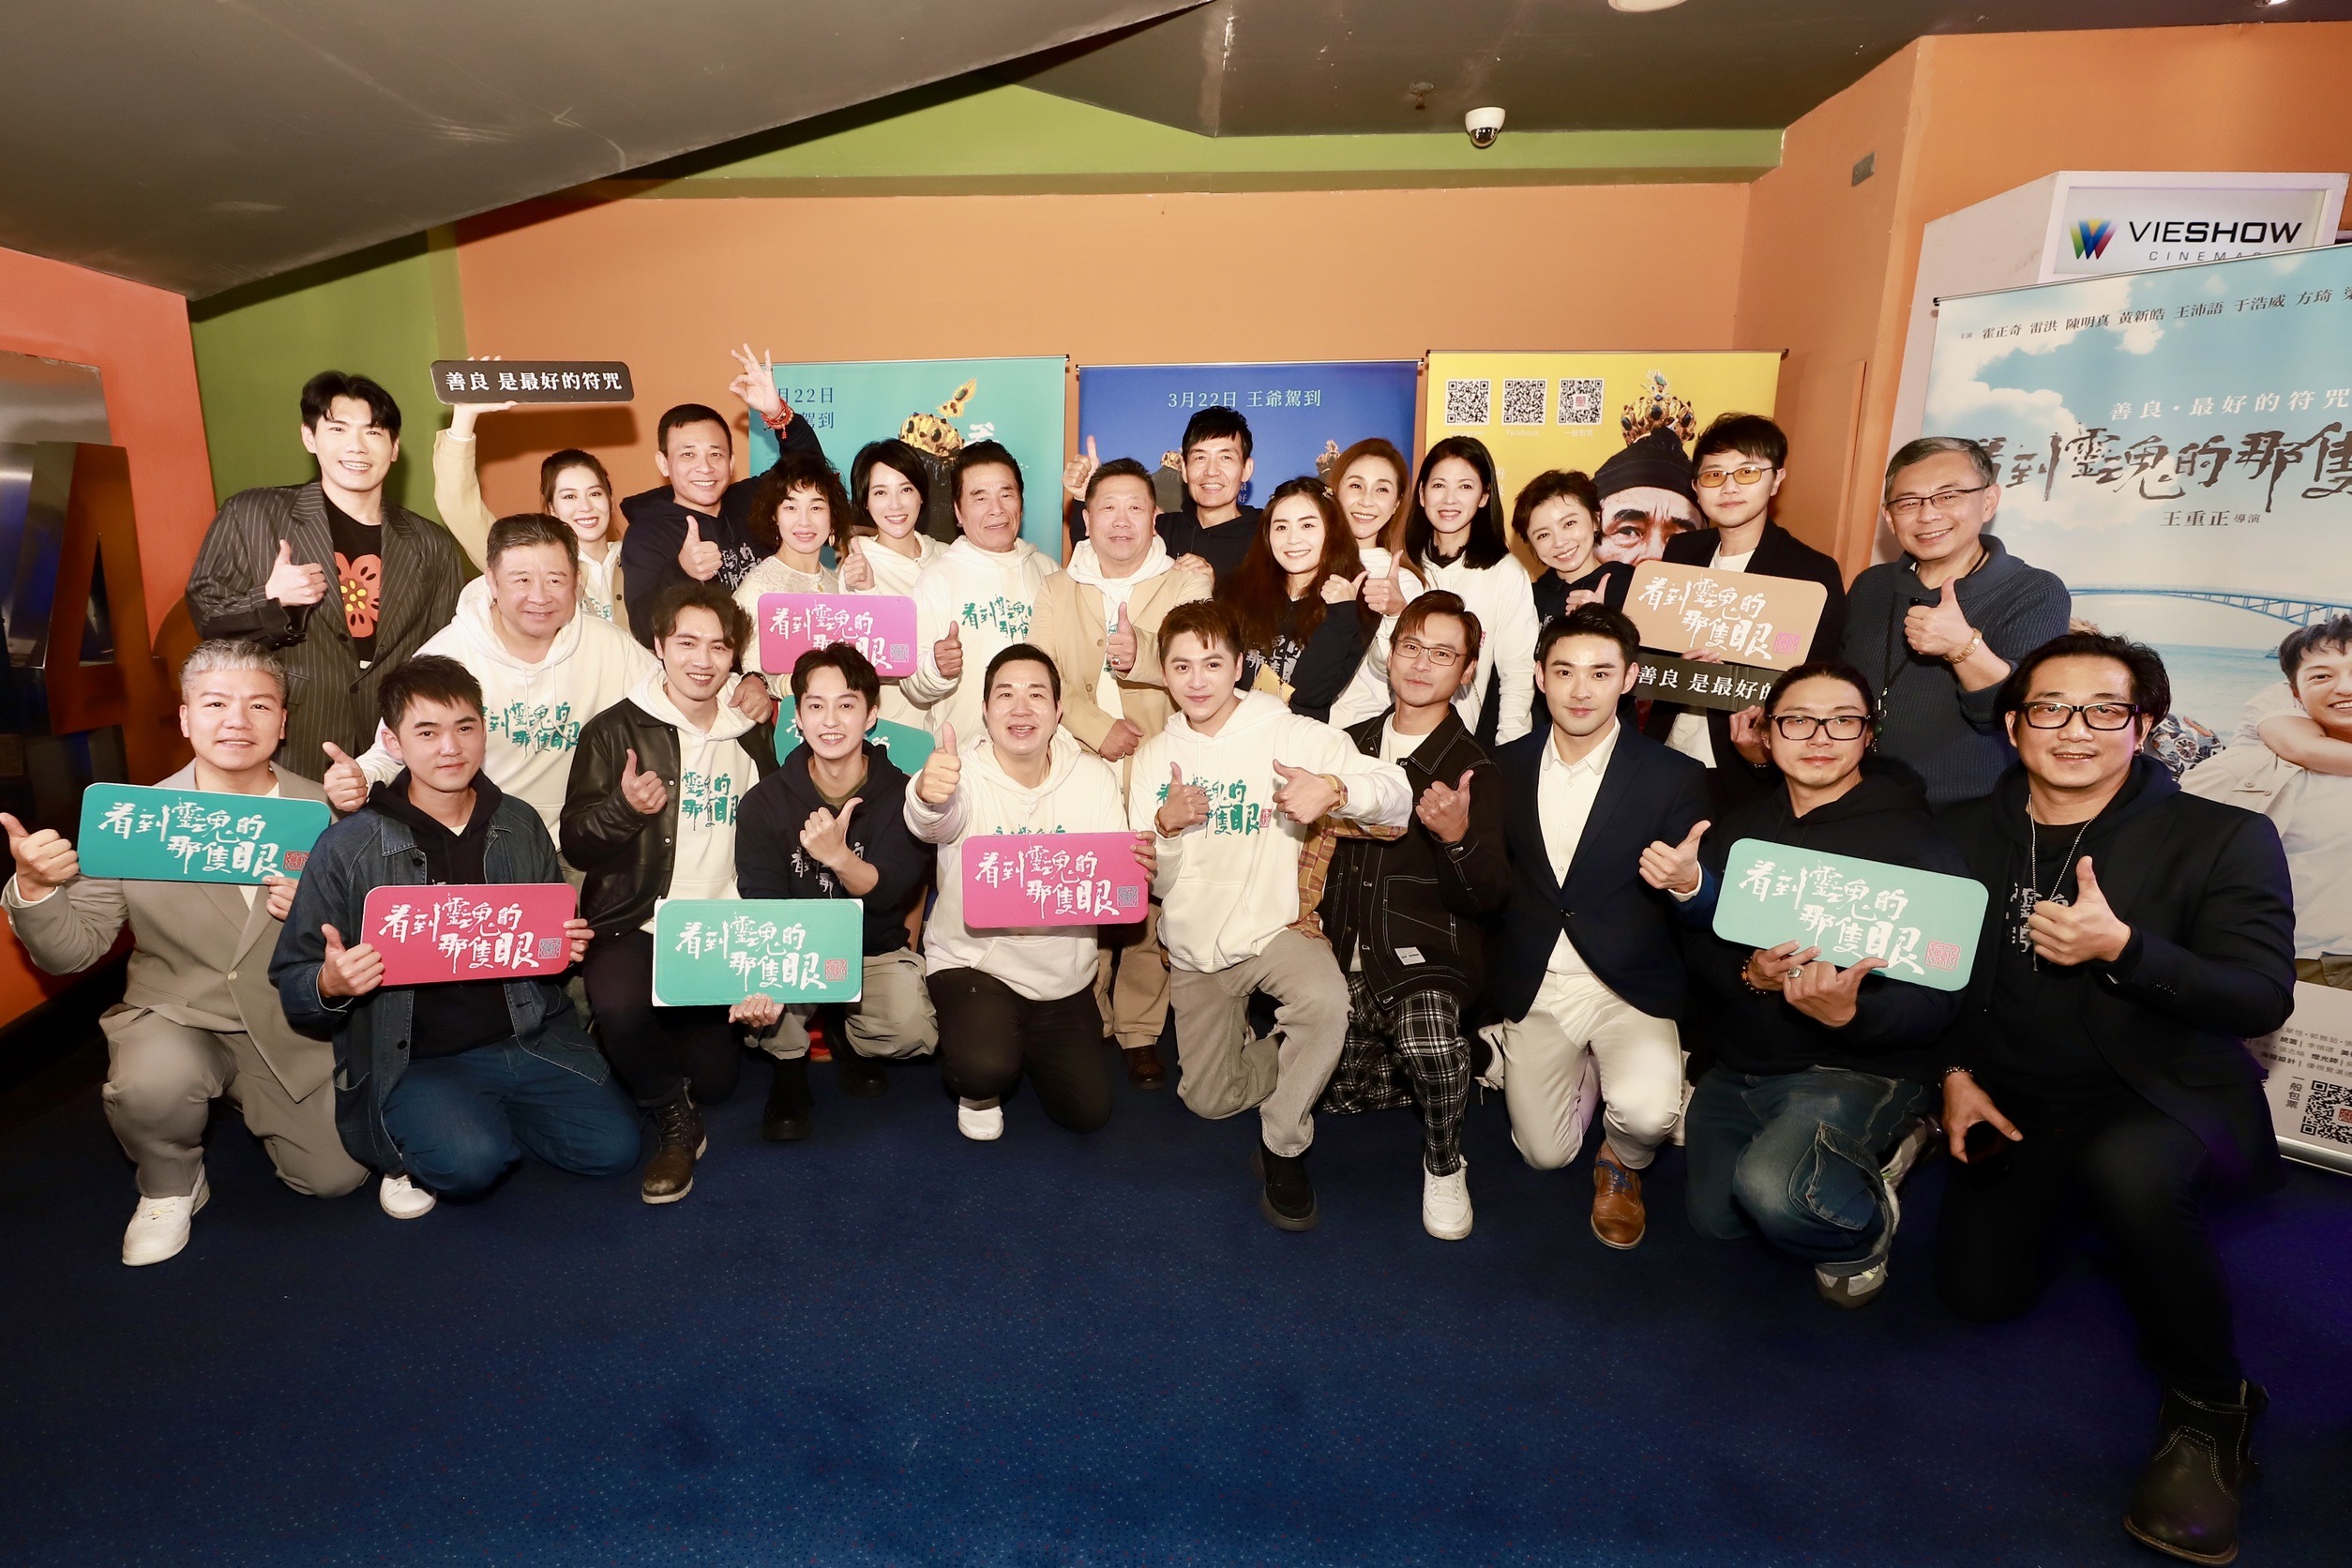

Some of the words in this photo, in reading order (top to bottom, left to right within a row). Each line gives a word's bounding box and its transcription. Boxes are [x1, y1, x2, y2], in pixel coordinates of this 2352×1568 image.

[2129, 221, 2302, 244] VIESHOW
[1983, 324, 2022, 339] 霍正奇
[2029, 320, 2058, 334] 雷洪
[2065, 314, 2110, 331] 陳明真
[2174, 301, 2224, 320] 王沛語
[2234, 294, 2286, 312] 于浩威
[2296, 289, 2333, 306] 方琦
[445, 371, 490, 391] 善良
[498, 372, 623, 391] 是最好的符咒
[1168, 391, 1237, 408] 3月22日
[1246, 389, 1321, 407] 王爺駕到
[1448, 429, 1485, 437] Instagram
[2161, 510, 2230, 528] 王重正
[2234, 513, 2261, 525] 導演
[1638, 573, 1767, 621] 看到靈魂的
[769, 599, 874, 641] 看到靈魂的
[1681, 610, 1773, 660] 那隻眼
[812, 634, 893, 670] 那眼
[1637, 665, 1680, 689] 善良
[482, 700, 571, 738] 到靈魂的
[98, 796, 266, 843] 看到靈魂的
[166, 836, 284, 878] 那隻眼
[975, 841, 1098, 889] 看到靈魂的
[1025, 879, 1121, 919] 那隻眼
[1739, 859, 1909, 922] 看到靈魂的
[378, 891, 523, 943] 看到靈魂的
[674, 912, 807, 960] 看到靈魂的
[438, 931, 540, 973] 那隻眼
[1800, 904, 1924, 975] 那隻眼
[729, 952, 827, 992] 那隻眼
